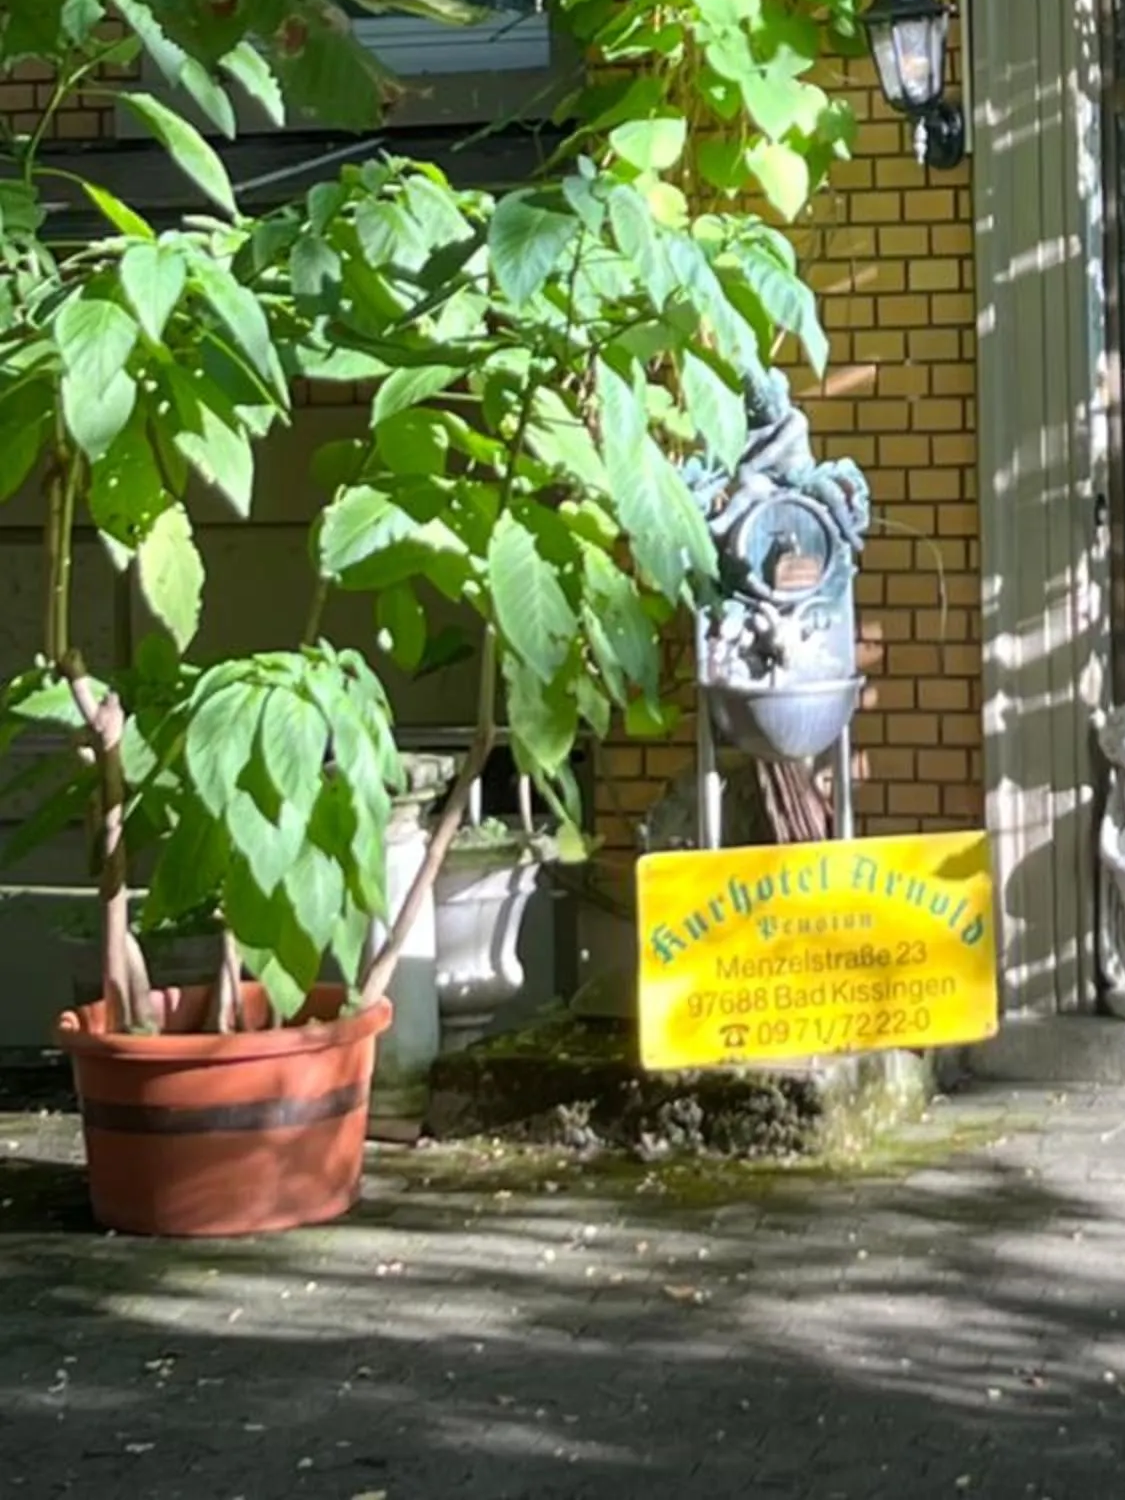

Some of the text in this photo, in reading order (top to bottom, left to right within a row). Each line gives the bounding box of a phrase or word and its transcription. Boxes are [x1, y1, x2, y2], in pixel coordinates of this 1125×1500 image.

[652, 854, 986, 964] Kurhotel Arnold
[715, 940, 928, 980] Menzelstraße 23
[687, 975, 956, 1018] 97688 Bad Kissingen
